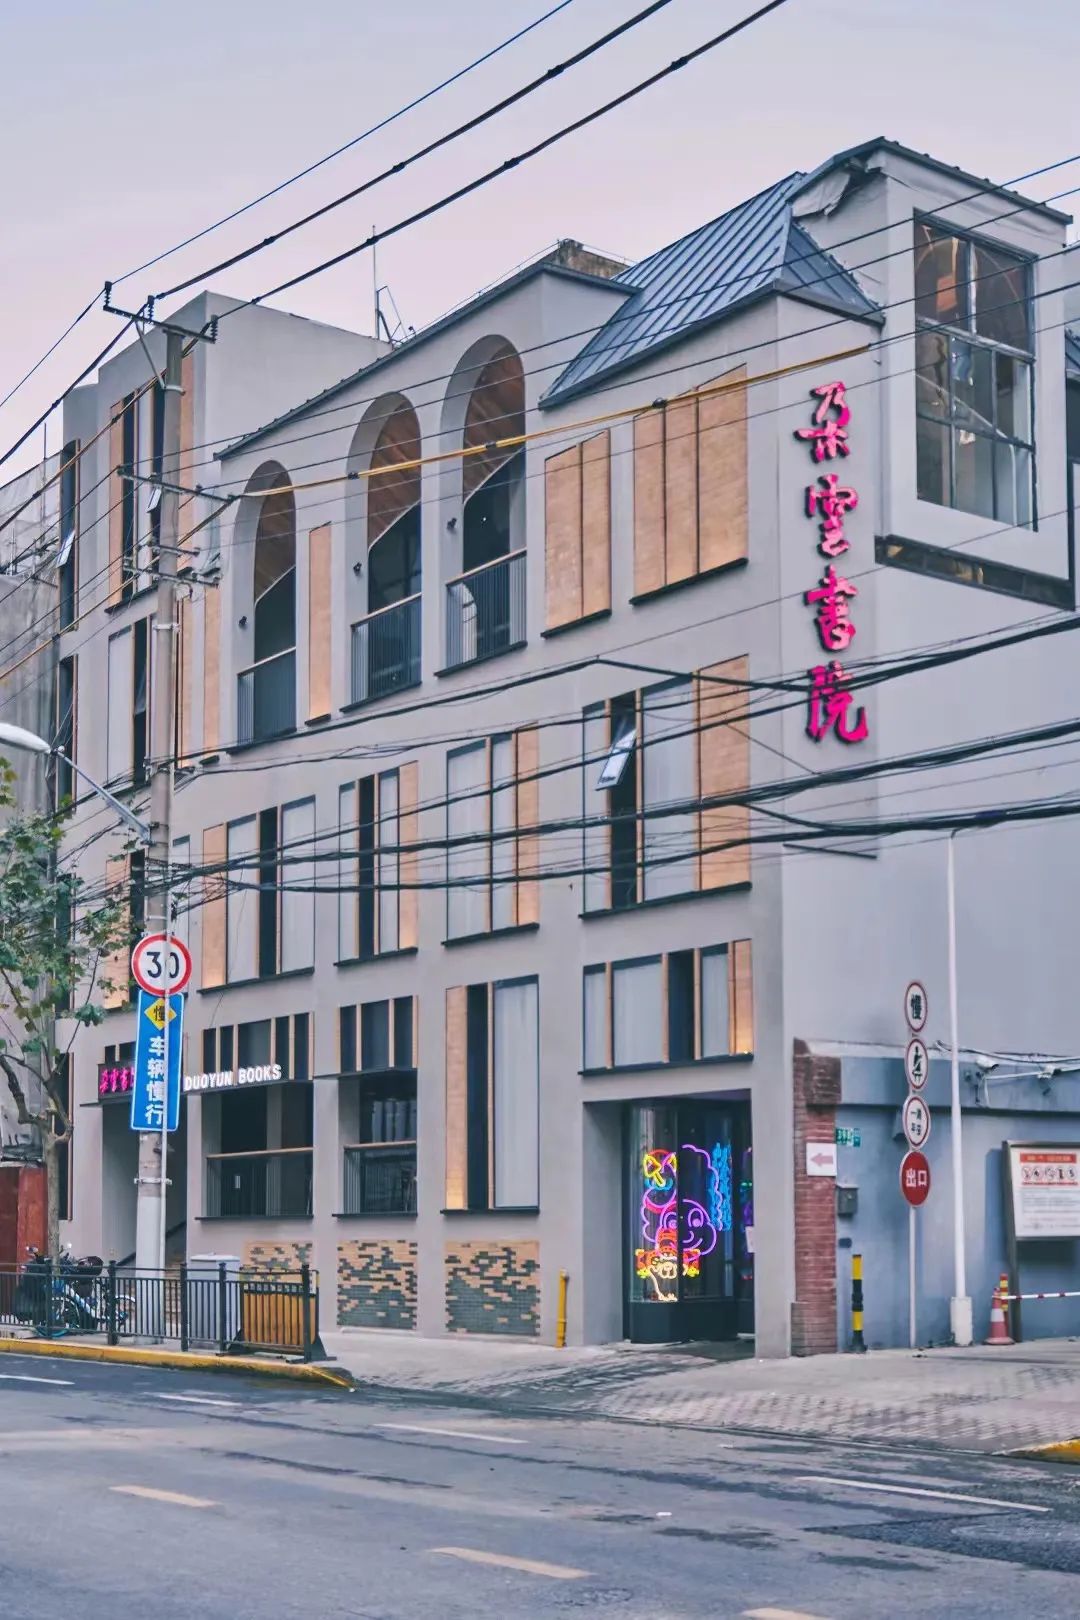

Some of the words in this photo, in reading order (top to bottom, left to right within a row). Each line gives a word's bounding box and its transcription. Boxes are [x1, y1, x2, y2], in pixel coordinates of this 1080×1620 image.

[146, 951, 180, 979] 30
[911, 994, 922, 1020] 慢
[184, 1070, 234, 1092] DUOYUN
[238, 1063, 282, 1085] BOOKS
[905, 1167, 928, 1188] 出口
